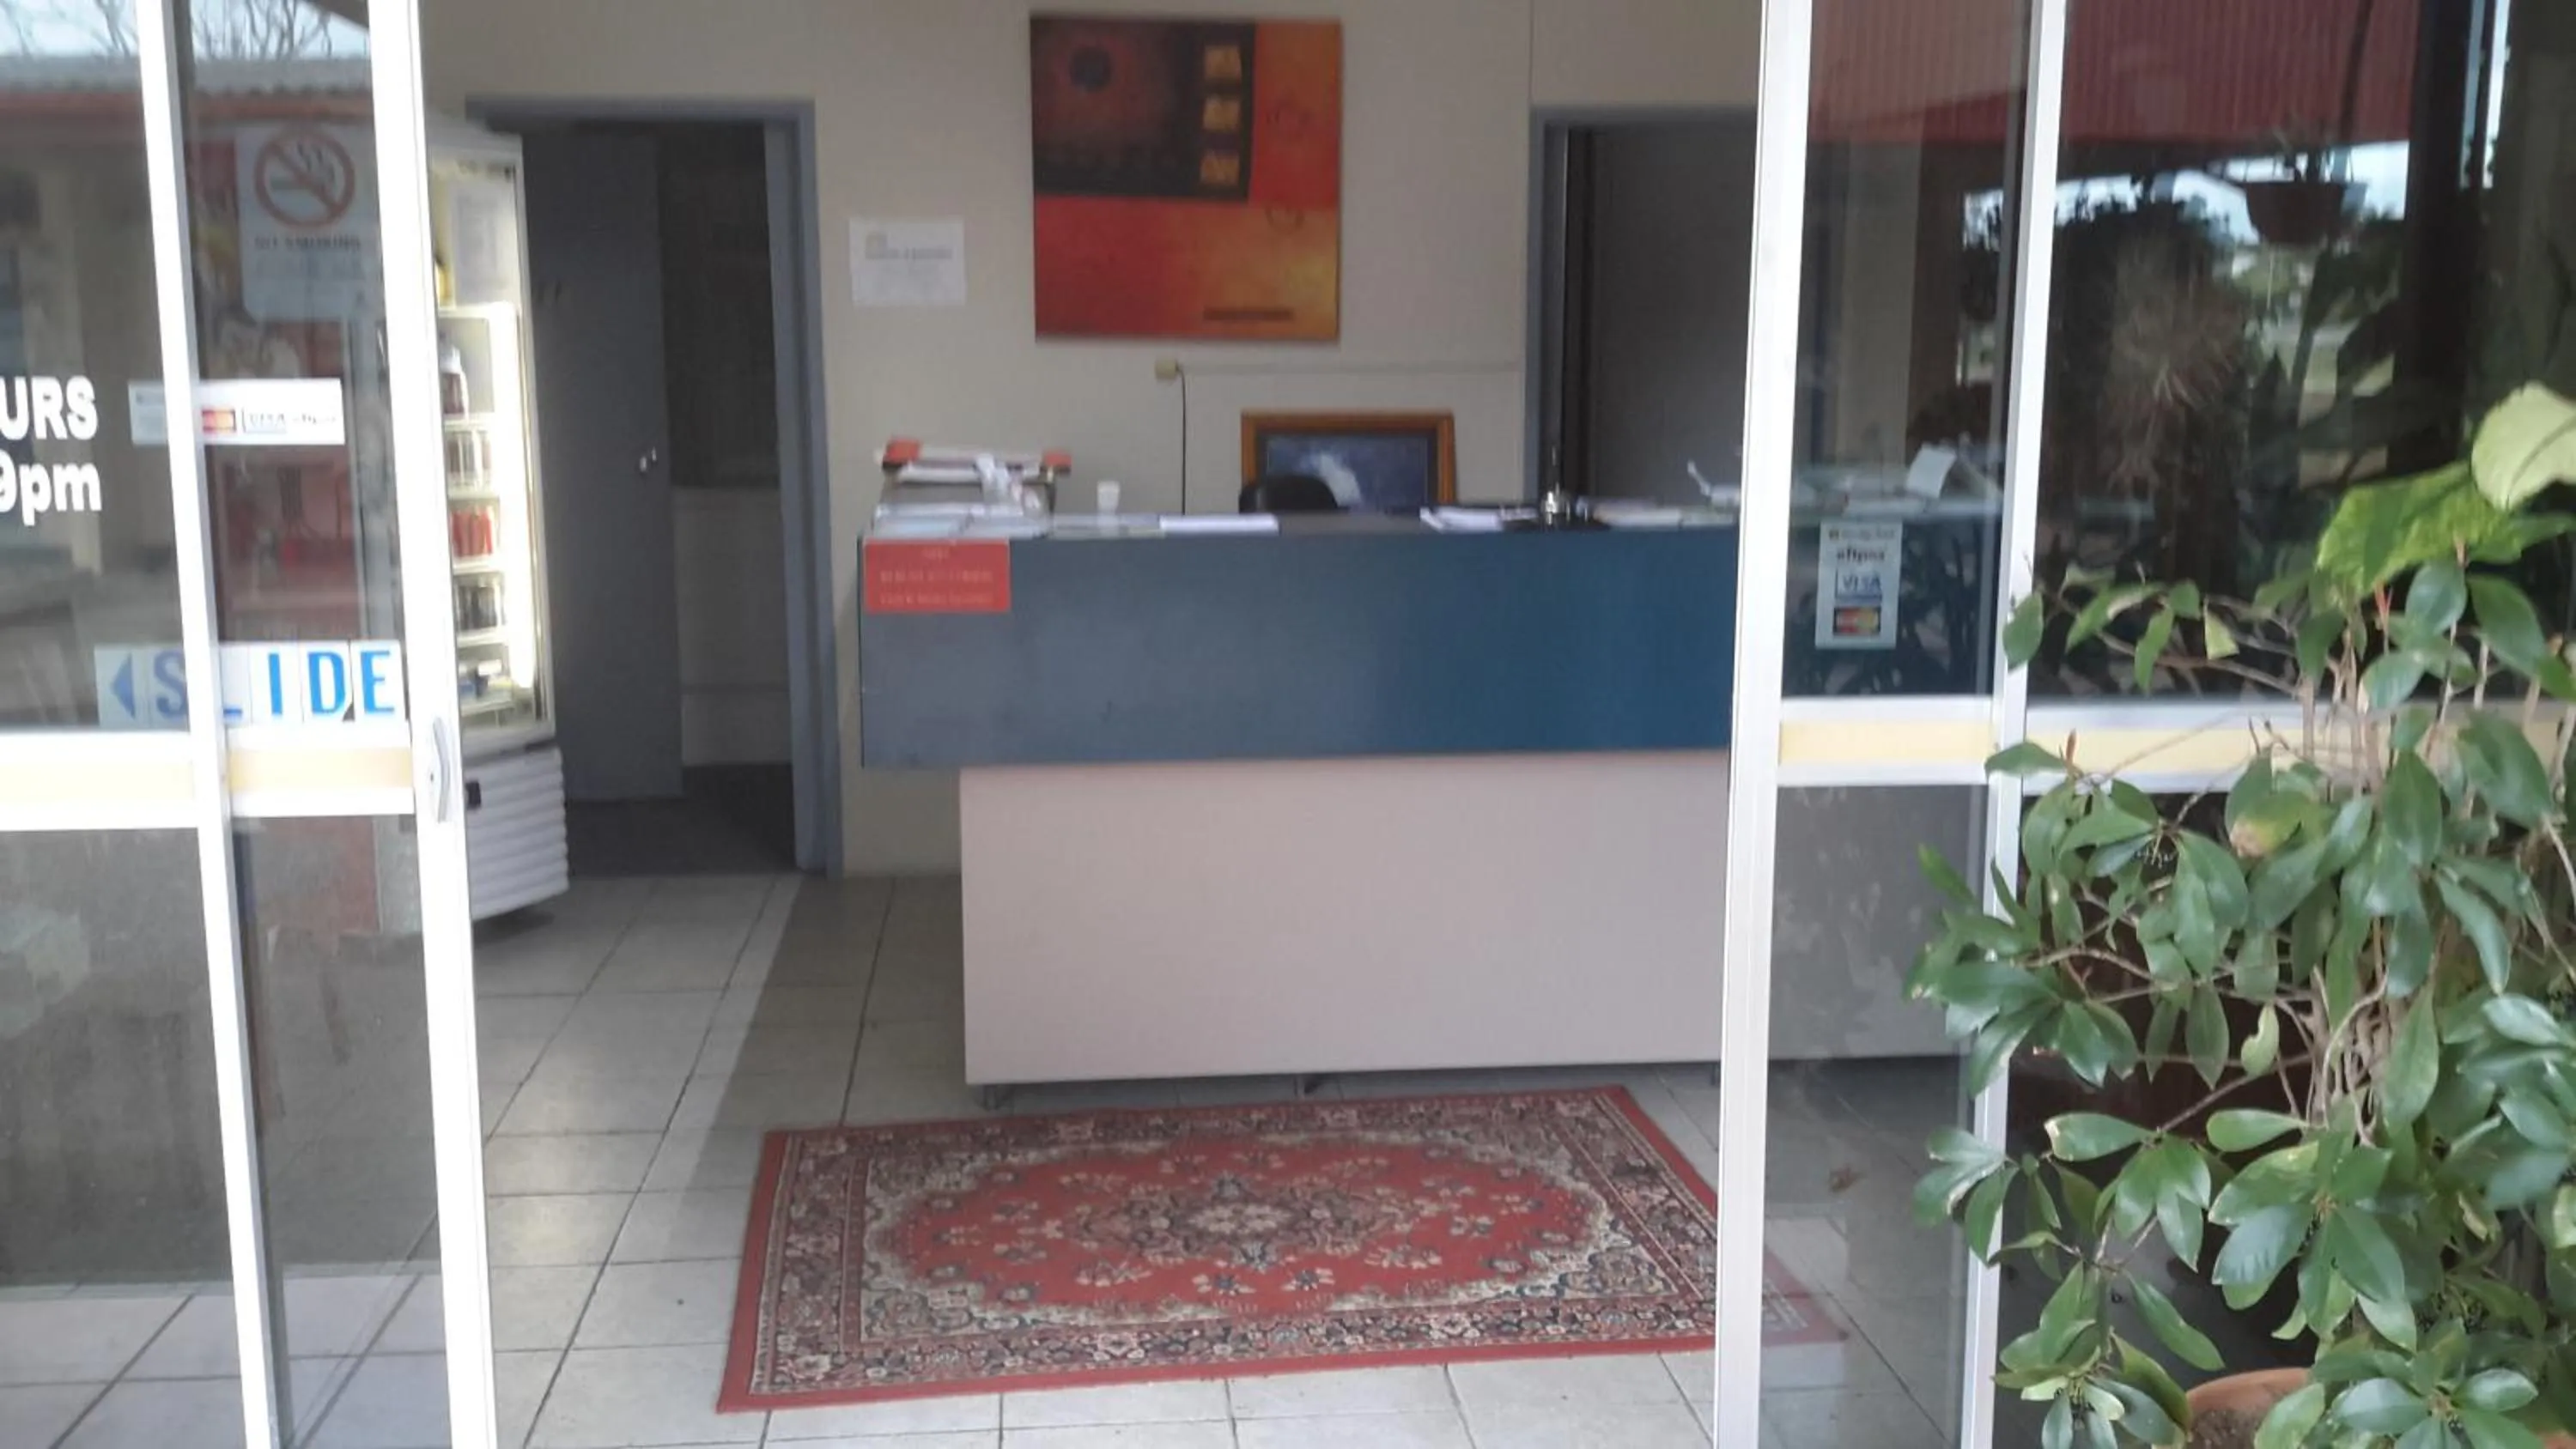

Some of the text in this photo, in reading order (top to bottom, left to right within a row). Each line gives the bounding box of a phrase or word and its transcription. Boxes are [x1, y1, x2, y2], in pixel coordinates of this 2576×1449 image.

[0, 375, 99, 440] URS
[0, 448, 102, 527] 9pm
[153, 649, 396, 718] SIDE
